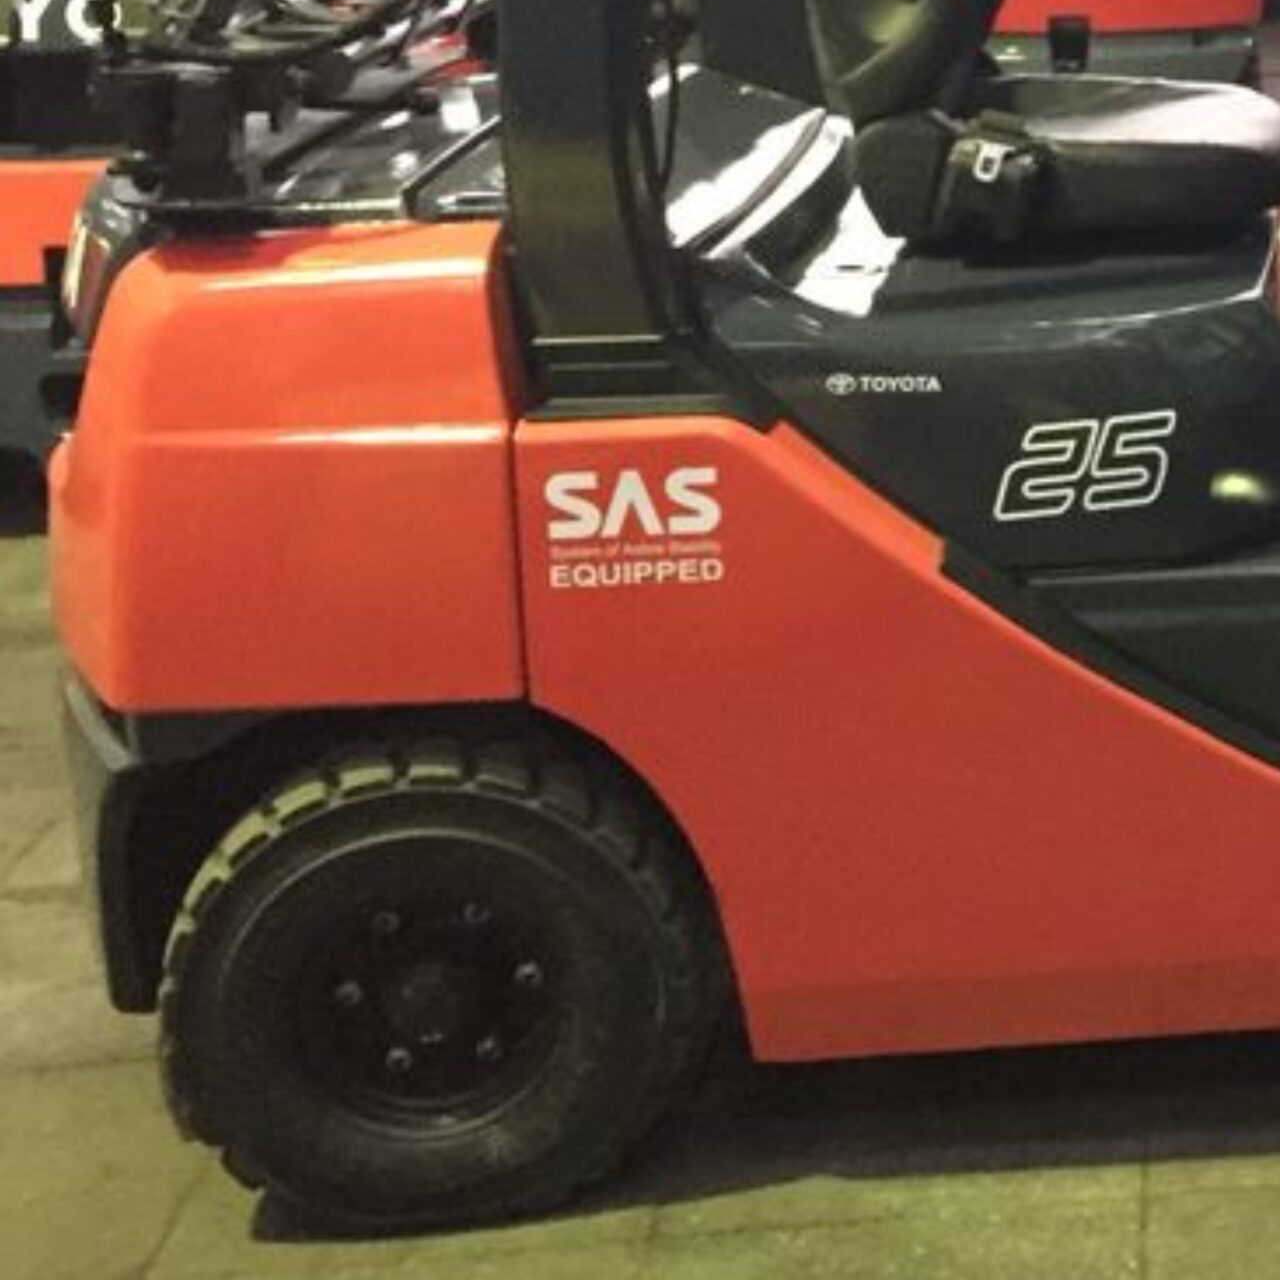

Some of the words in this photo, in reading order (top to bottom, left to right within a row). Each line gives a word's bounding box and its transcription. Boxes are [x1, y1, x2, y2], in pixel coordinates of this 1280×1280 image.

[858, 375, 943, 393] TOYOTA
[993, 407, 1177, 521] 25
[544, 466, 723, 541] SAS
[550, 557, 725, 589] EQUIPPED
